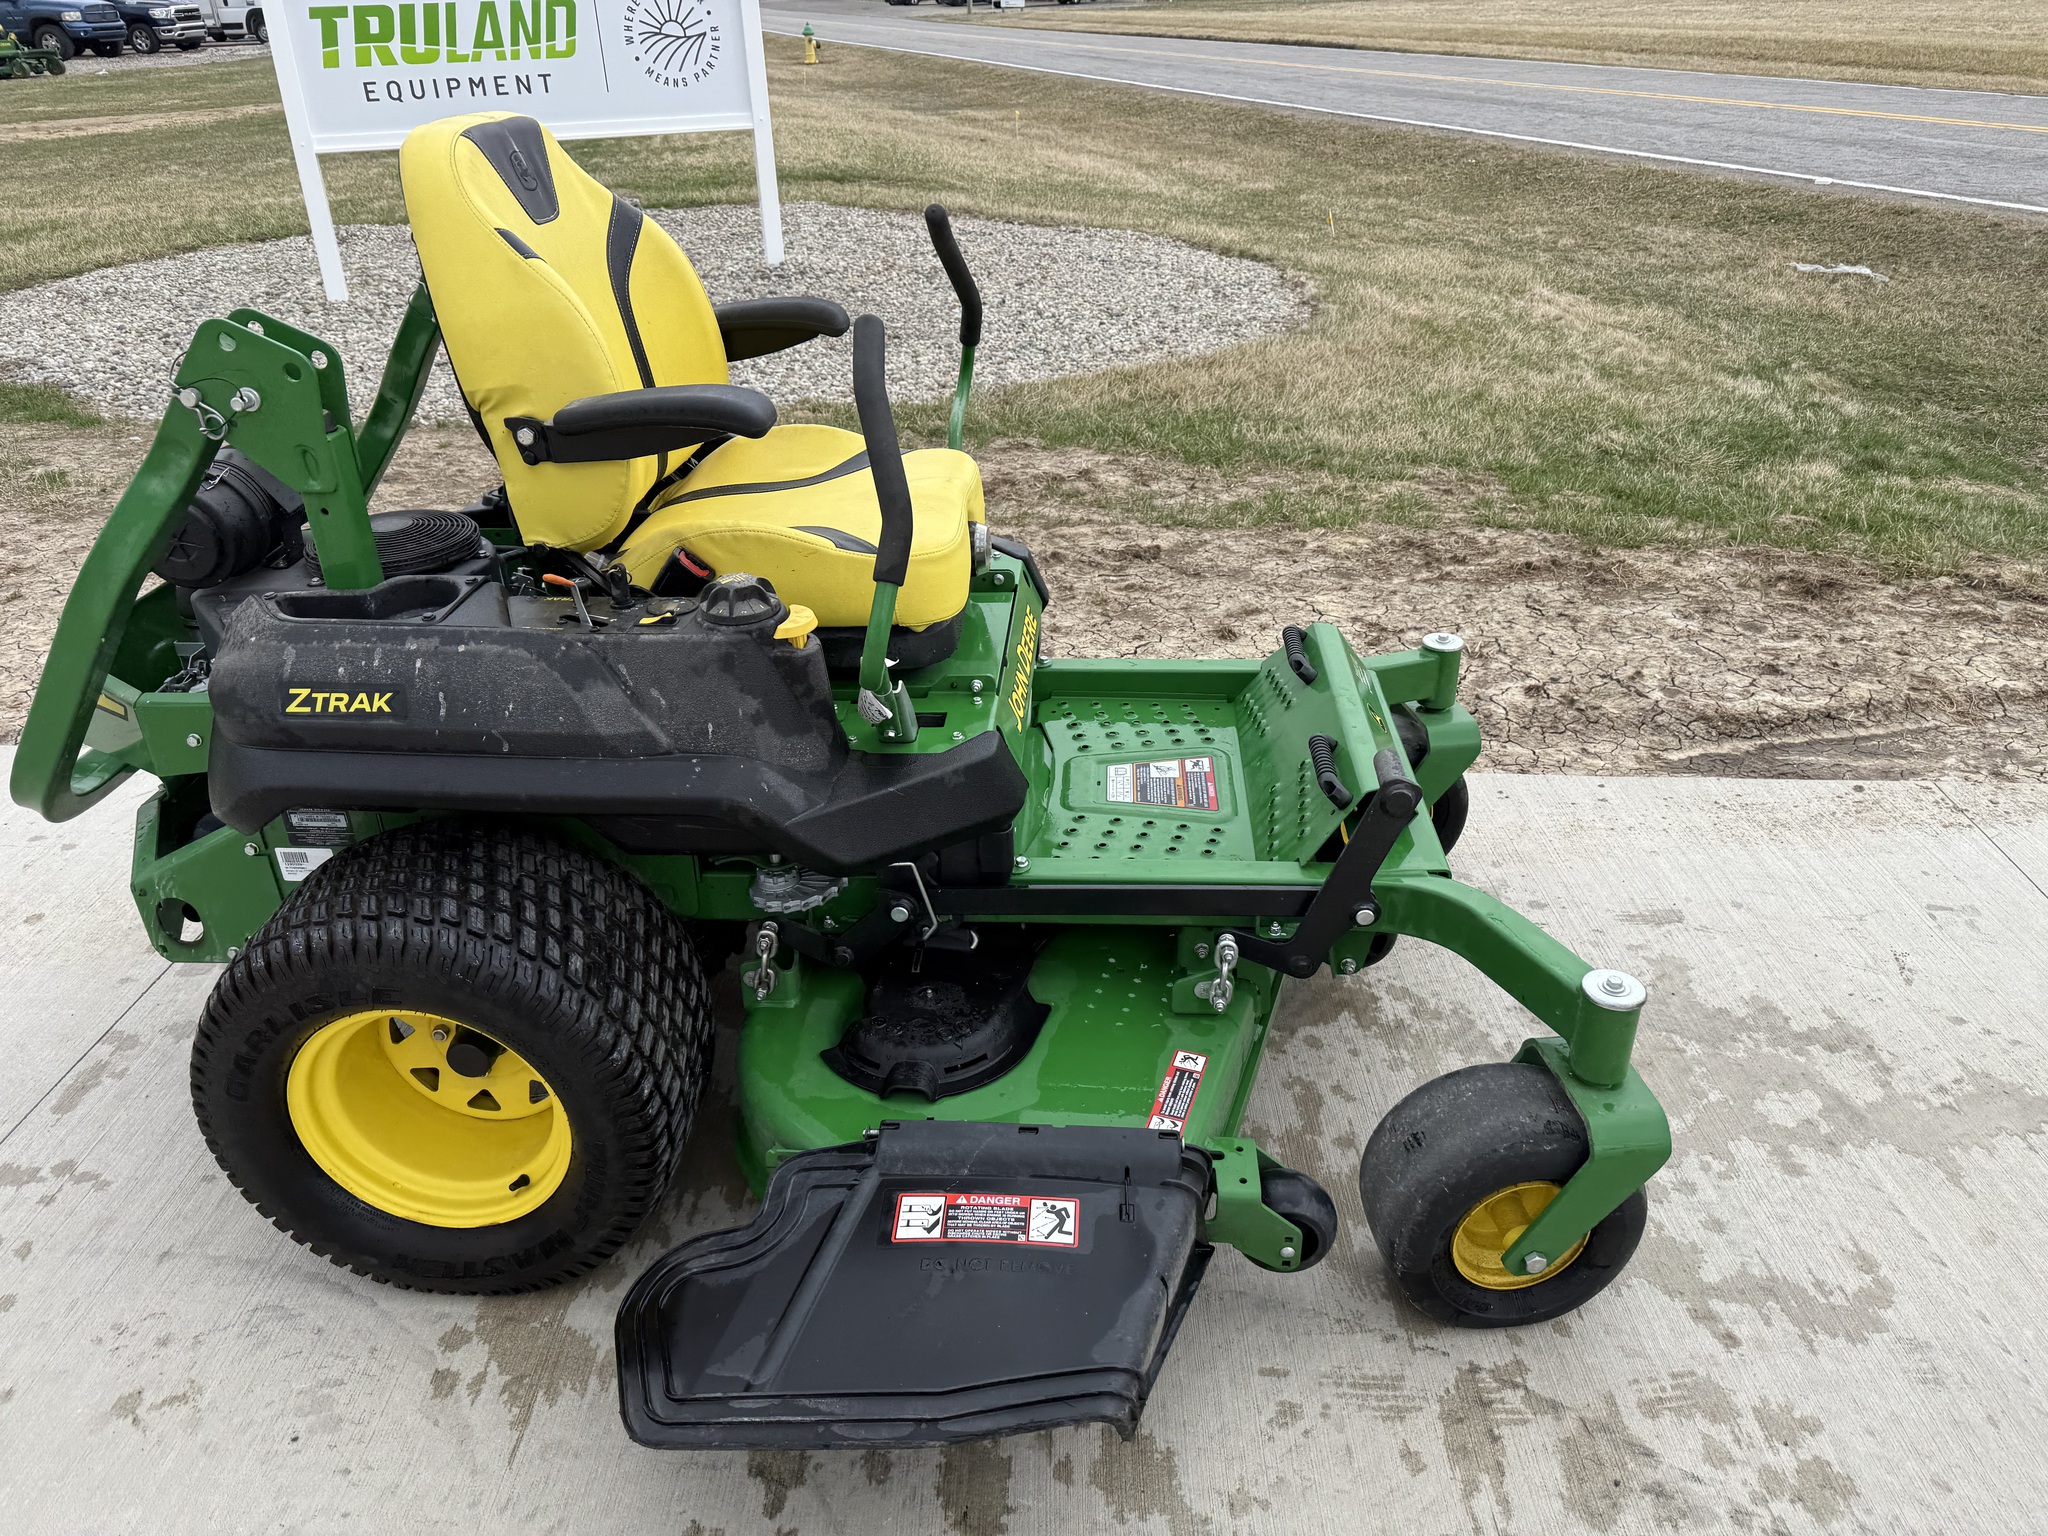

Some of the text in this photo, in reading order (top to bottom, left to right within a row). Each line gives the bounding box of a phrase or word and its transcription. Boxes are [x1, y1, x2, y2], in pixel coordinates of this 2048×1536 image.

[308, 0, 577, 69] TRULAND
[623, 0, 641, 46] WHERE
[644, 25, 721, 88] MEANS PARTNER
[362, 73, 552, 103] EQUIPMENT
[1008, 604, 1038, 734] JOHN DEERE
[285, 688, 394, 713] ZTRAK
[224, 985, 402, 1102] CARLISLE
[1158, 1076, 1173, 1099] DANGER
[970, 1196, 1021, 1205] DANGER
[955, 1257, 992, 1273] NOT
